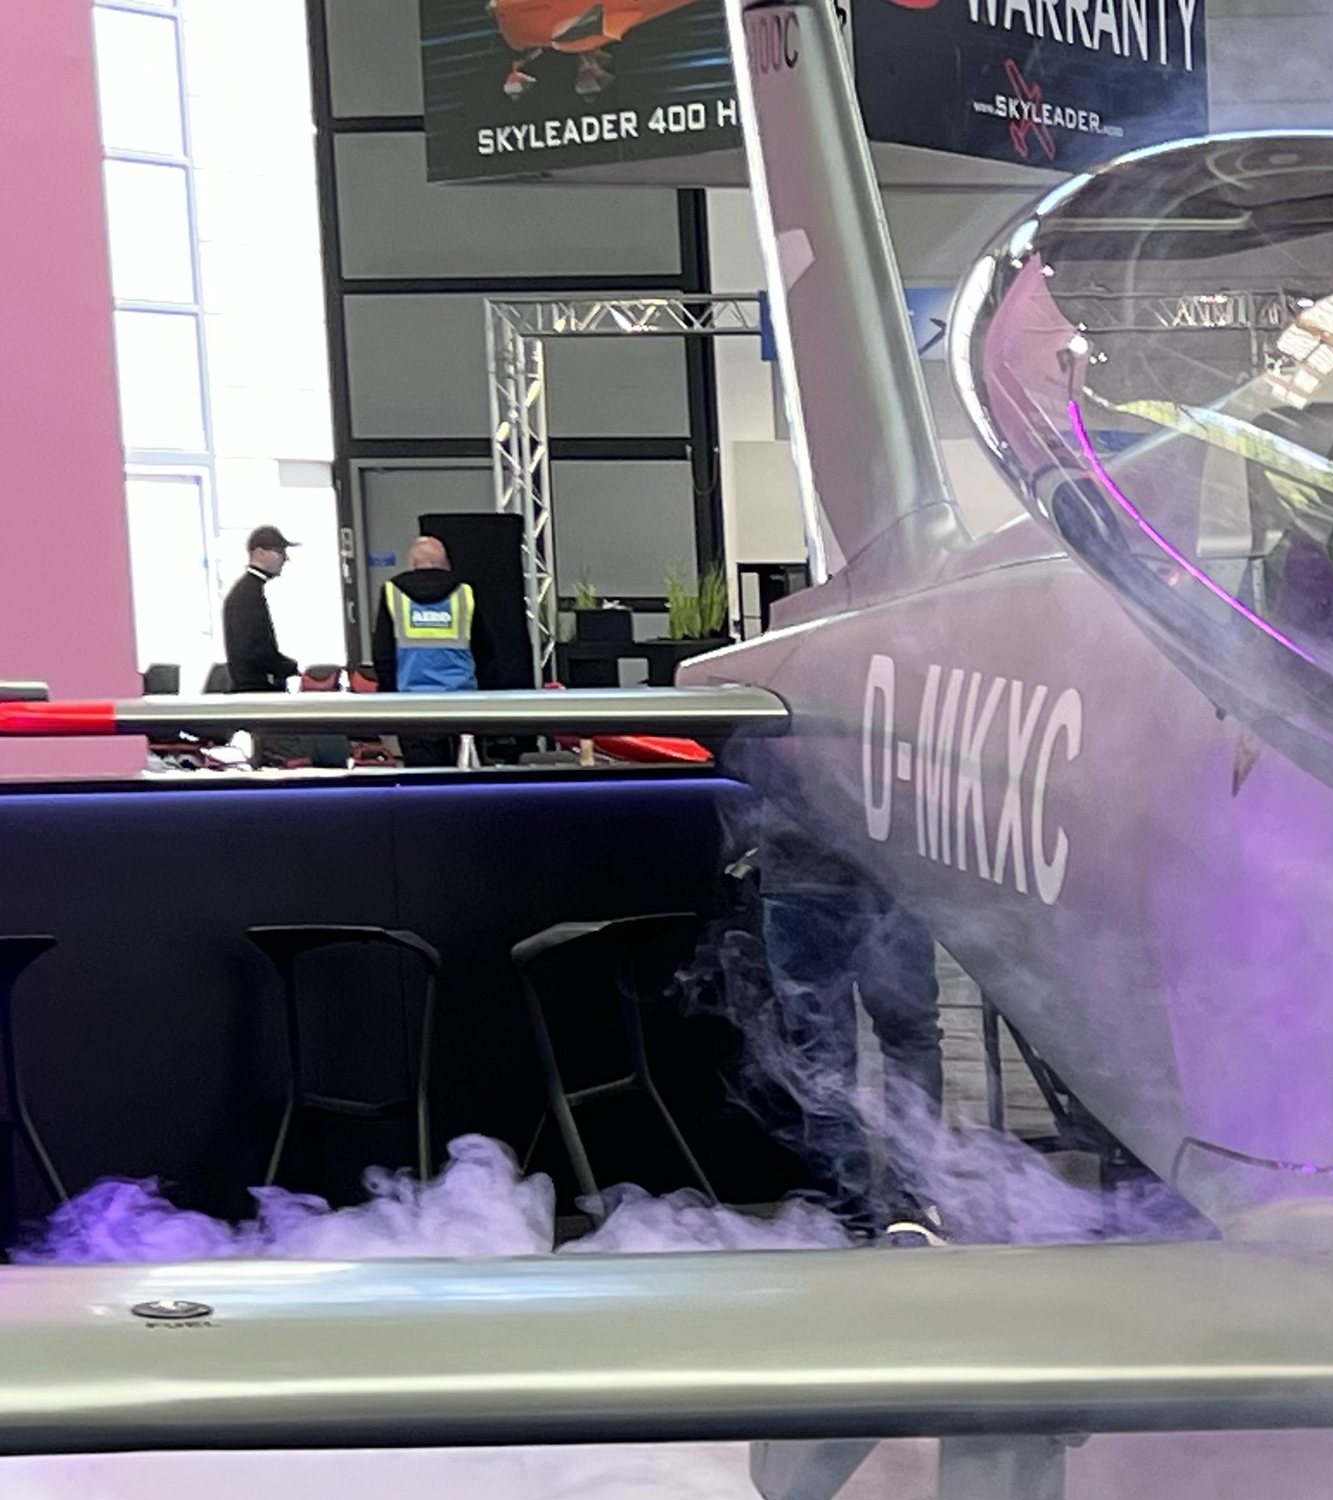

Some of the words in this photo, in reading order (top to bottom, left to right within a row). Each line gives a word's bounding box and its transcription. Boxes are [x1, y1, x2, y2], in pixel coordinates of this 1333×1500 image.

[477, 110, 640, 155] SKYLEADER
[648, 101, 706, 134] 400
[862, 653, 1083, 906] D-MKXC
